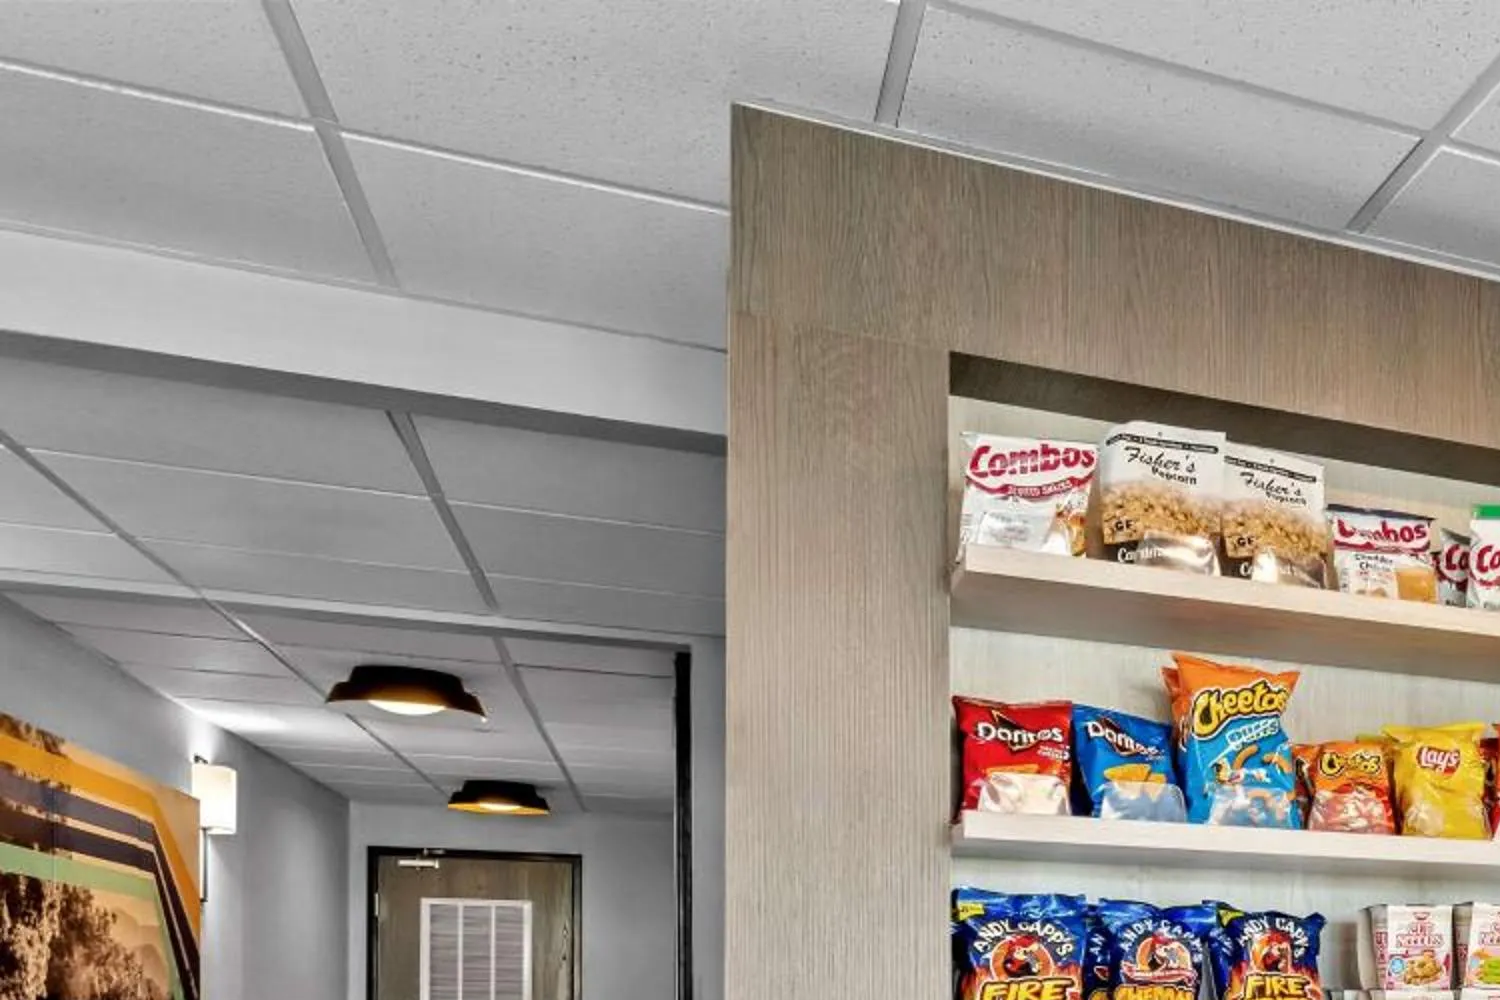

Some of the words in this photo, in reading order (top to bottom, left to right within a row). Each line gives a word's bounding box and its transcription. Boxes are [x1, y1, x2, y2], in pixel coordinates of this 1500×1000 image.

[969, 444, 1095, 478] Combos
[1124, 446, 1197, 473] Fisher's
[1240, 471, 1302, 497] Fisher's
[1193, 681, 1288, 737] Cheetos
[977, 721, 1064, 743] Doritos
[973, 919, 1014, 953] ANDY
